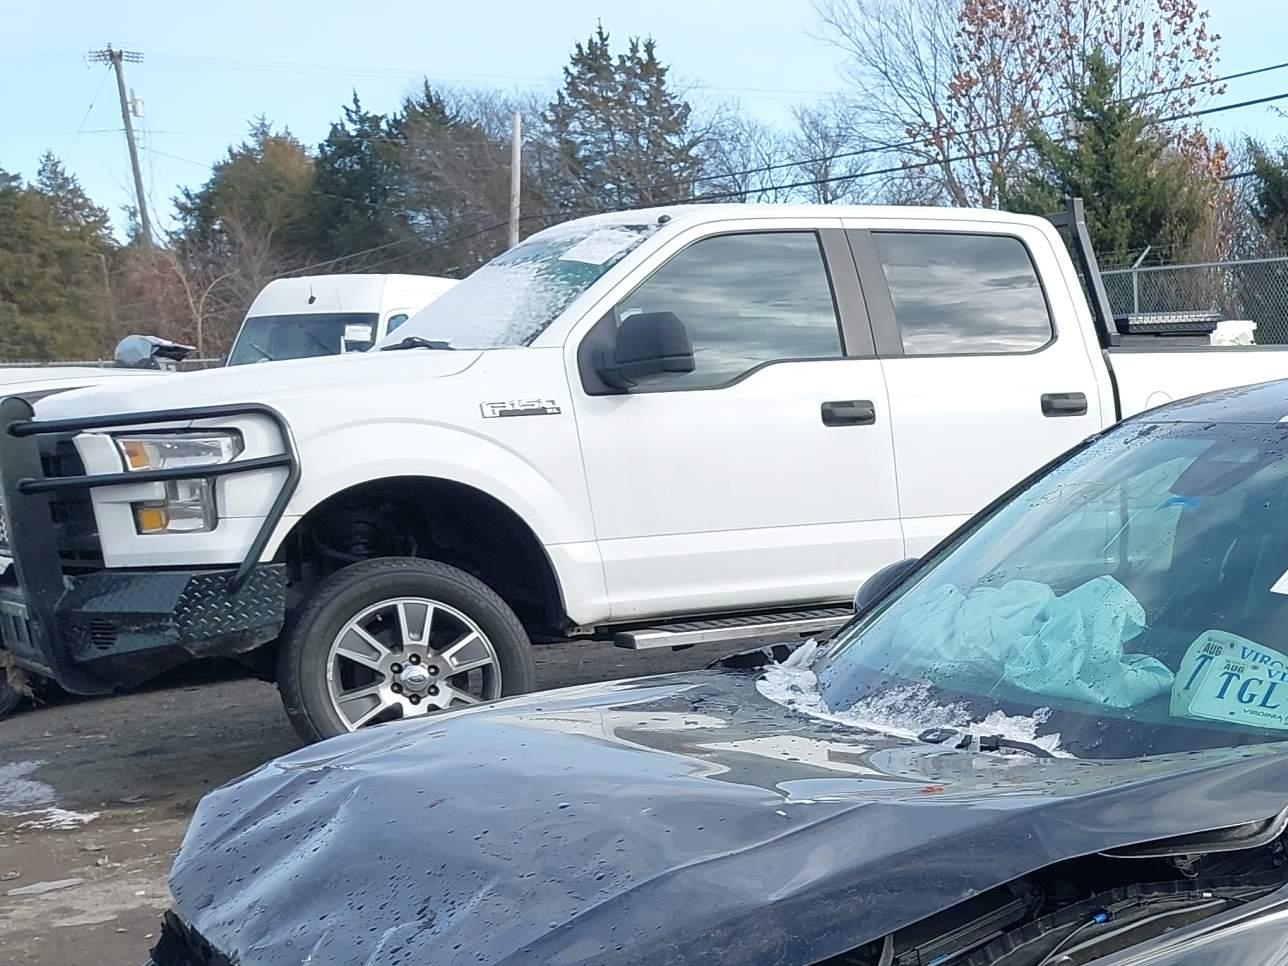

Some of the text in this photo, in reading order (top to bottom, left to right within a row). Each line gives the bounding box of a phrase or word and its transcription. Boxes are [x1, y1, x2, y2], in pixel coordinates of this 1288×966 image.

[1203, 642, 1224, 657] AUG
[1224, 663, 1245, 674] AUG
[1243, 707, 1283, 722] VIRGINIA
